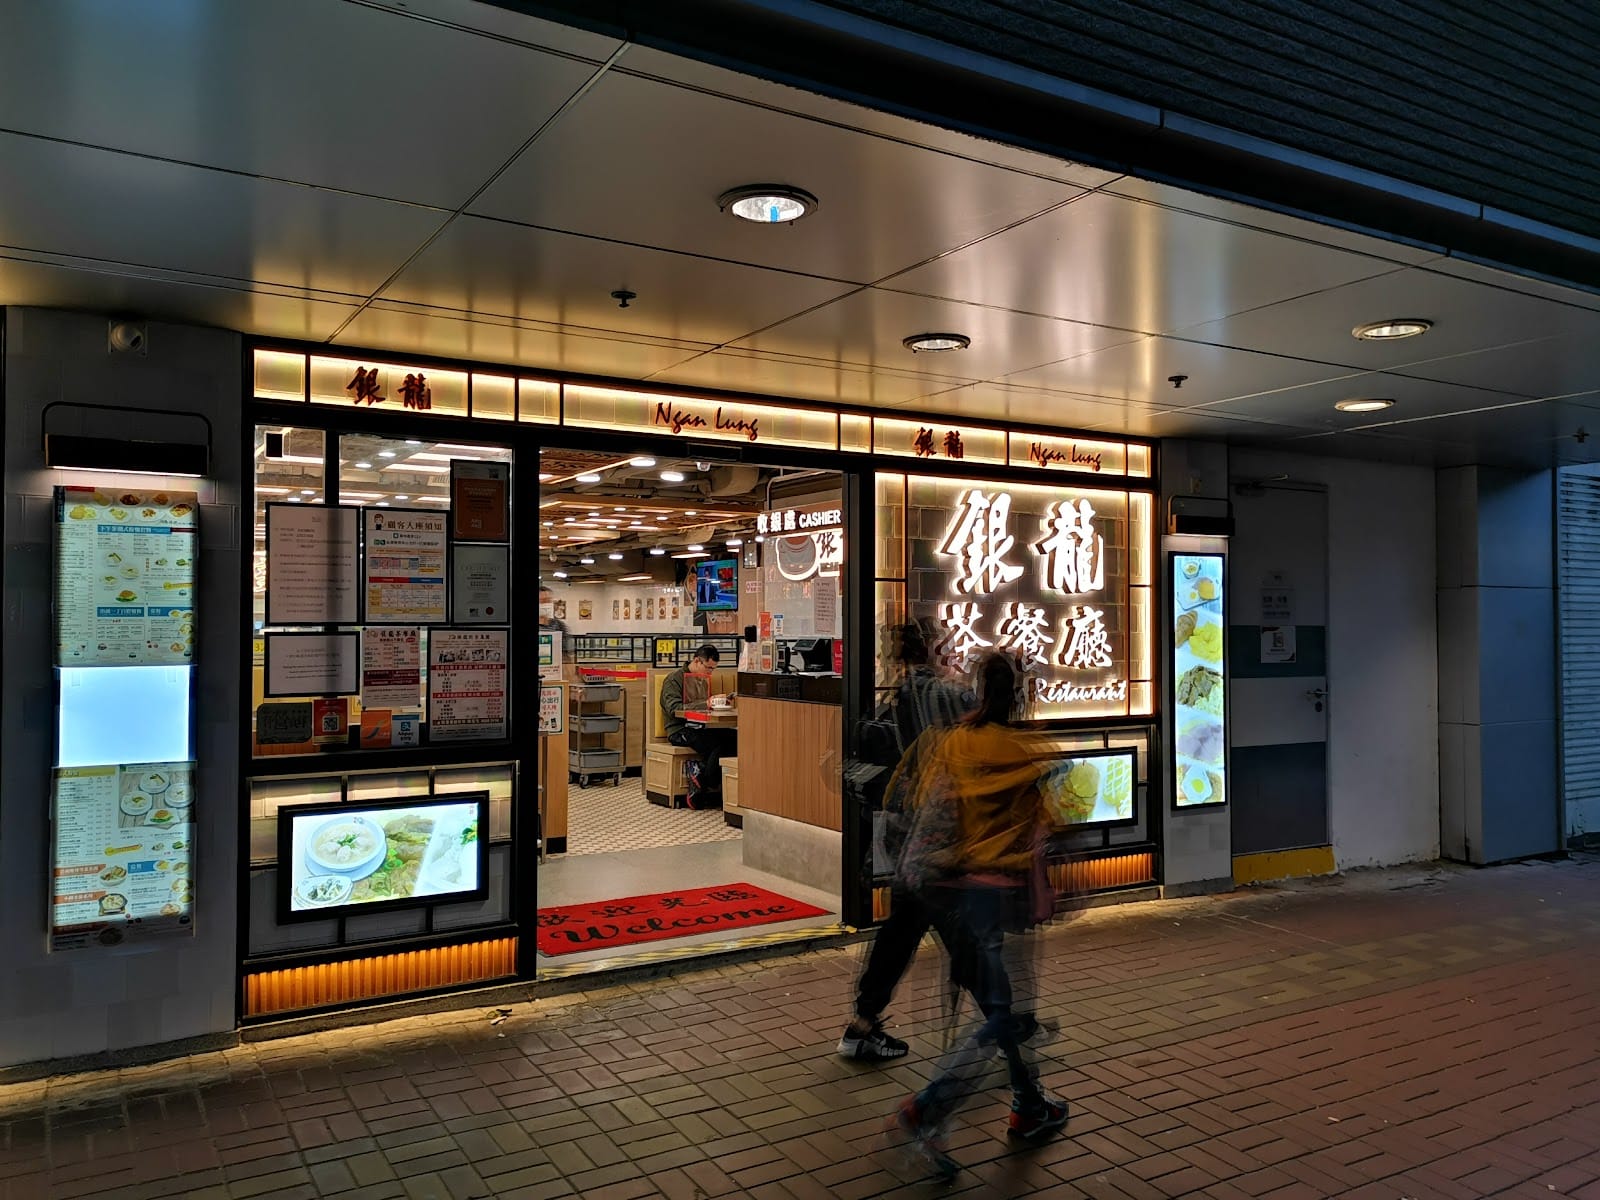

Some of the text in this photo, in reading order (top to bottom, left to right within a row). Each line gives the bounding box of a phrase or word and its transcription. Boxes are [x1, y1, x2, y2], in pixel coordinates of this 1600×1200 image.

[346, 366, 432, 410] 銀龍
[655, 401, 759, 440] Ngan Lung
[914, 427, 964, 459] 銀龍
[1030, 442, 1102, 471] Ngan Lung
[799, 509, 841, 529] CASHIER
[938, 489, 1104, 594] 銀龍
[938, 601, 1113, 674] 茶餐廳
[1033, 678, 1127, 704] Restaurant
[550, 904, 794, 943] Welcome
